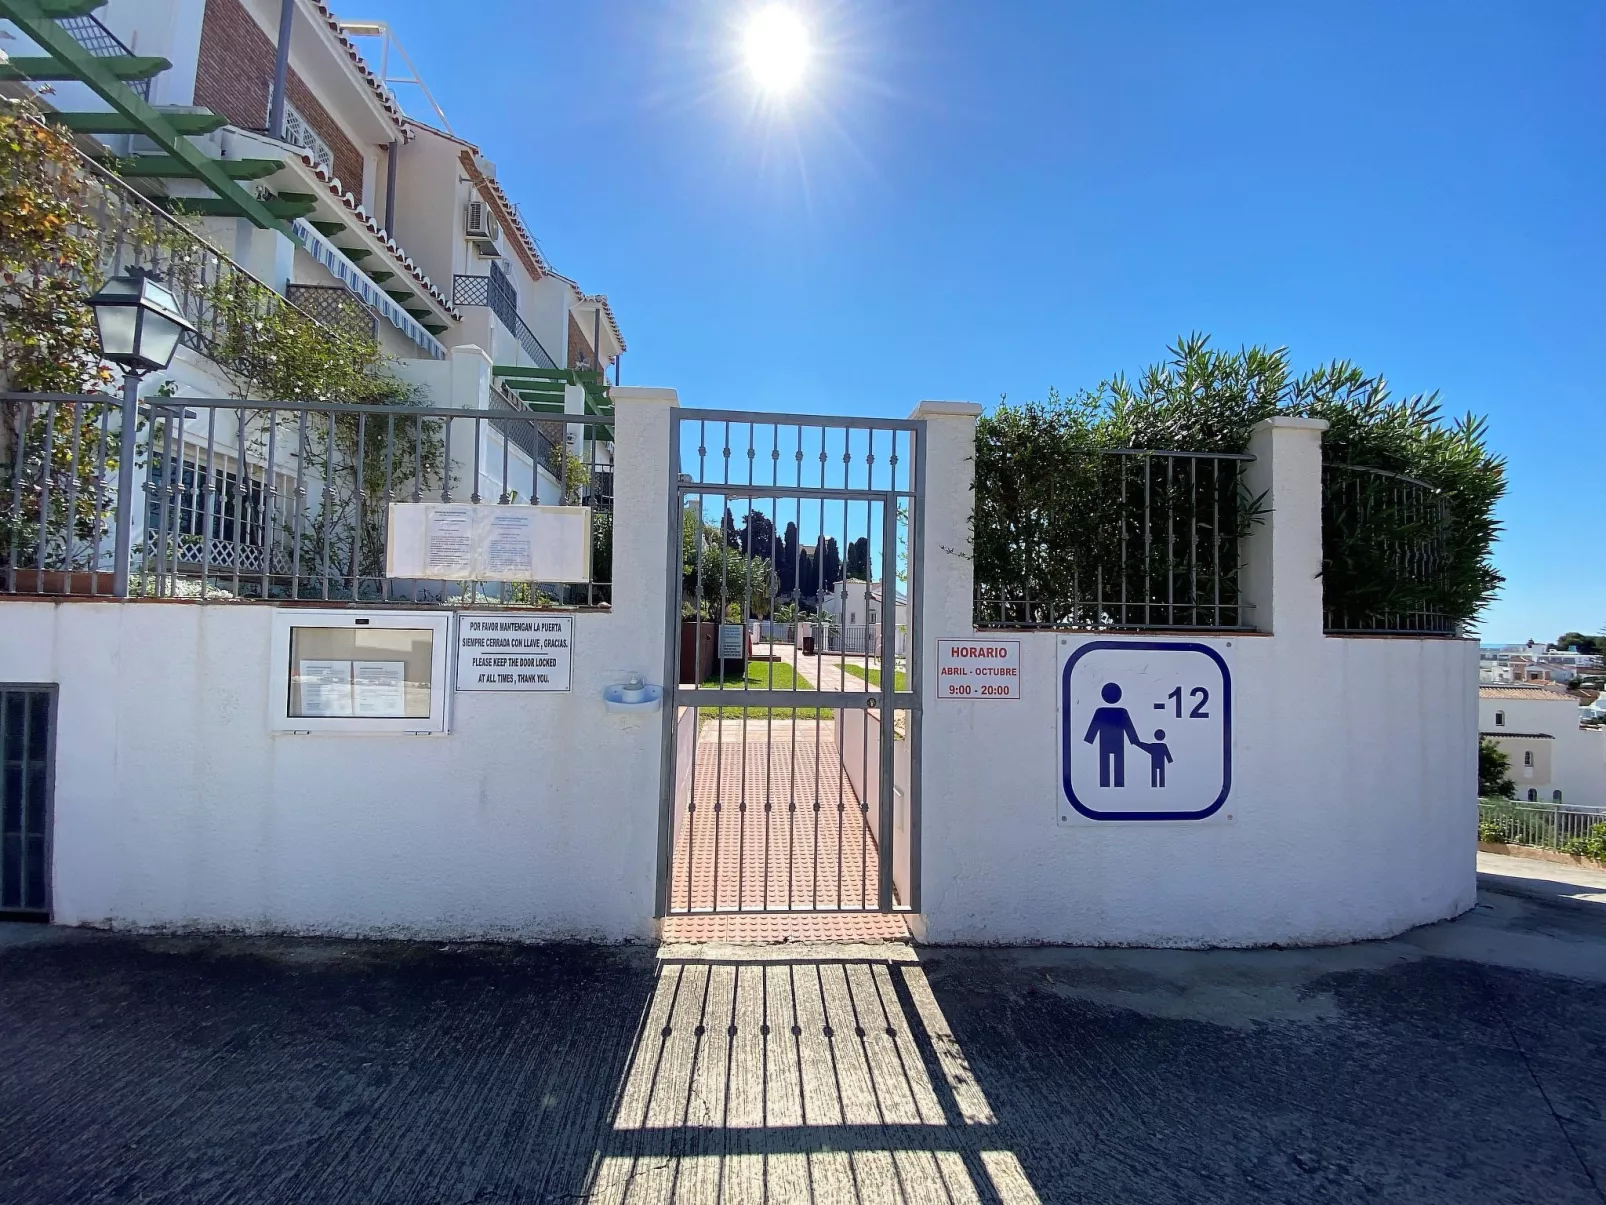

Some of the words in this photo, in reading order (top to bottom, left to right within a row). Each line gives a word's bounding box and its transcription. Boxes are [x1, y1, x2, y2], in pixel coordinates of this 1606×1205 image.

[470, 622, 481, 631] POR
[482, 622, 498, 631] FAVOR
[500, 622, 532, 632] MANTENGAN
[533, 623, 540, 632] LA
[542, 623, 561, 632] PUERTA
[462, 638, 485, 647] SIEMPRE
[486, 638, 510, 647] CERRADA
[512, 639, 521, 647] CON
[544, 639, 568, 648] GRACIAS.
[951, 647, 1007, 658] HORARIO
[472, 658, 492, 666] PLEASE
[493, 658, 507, 667] KEEP
[509, 658, 519, 667] THE
[520, 658, 534, 667] DOOR
[536, 659, 556, 667] LOCKED
[975, 668, 1017, 676] OCTUBRE
[478, 674, 485, 682] AT
[487, 674, 496, 683] ALL
[518, 674, 536, 683] THANK
[537, 675, 549, 683] YOU.
[949, 685, 971, 694] 9:00
[981, 686, 1009, 695] 20:00
[1153, 686, 1210, 719] -12
